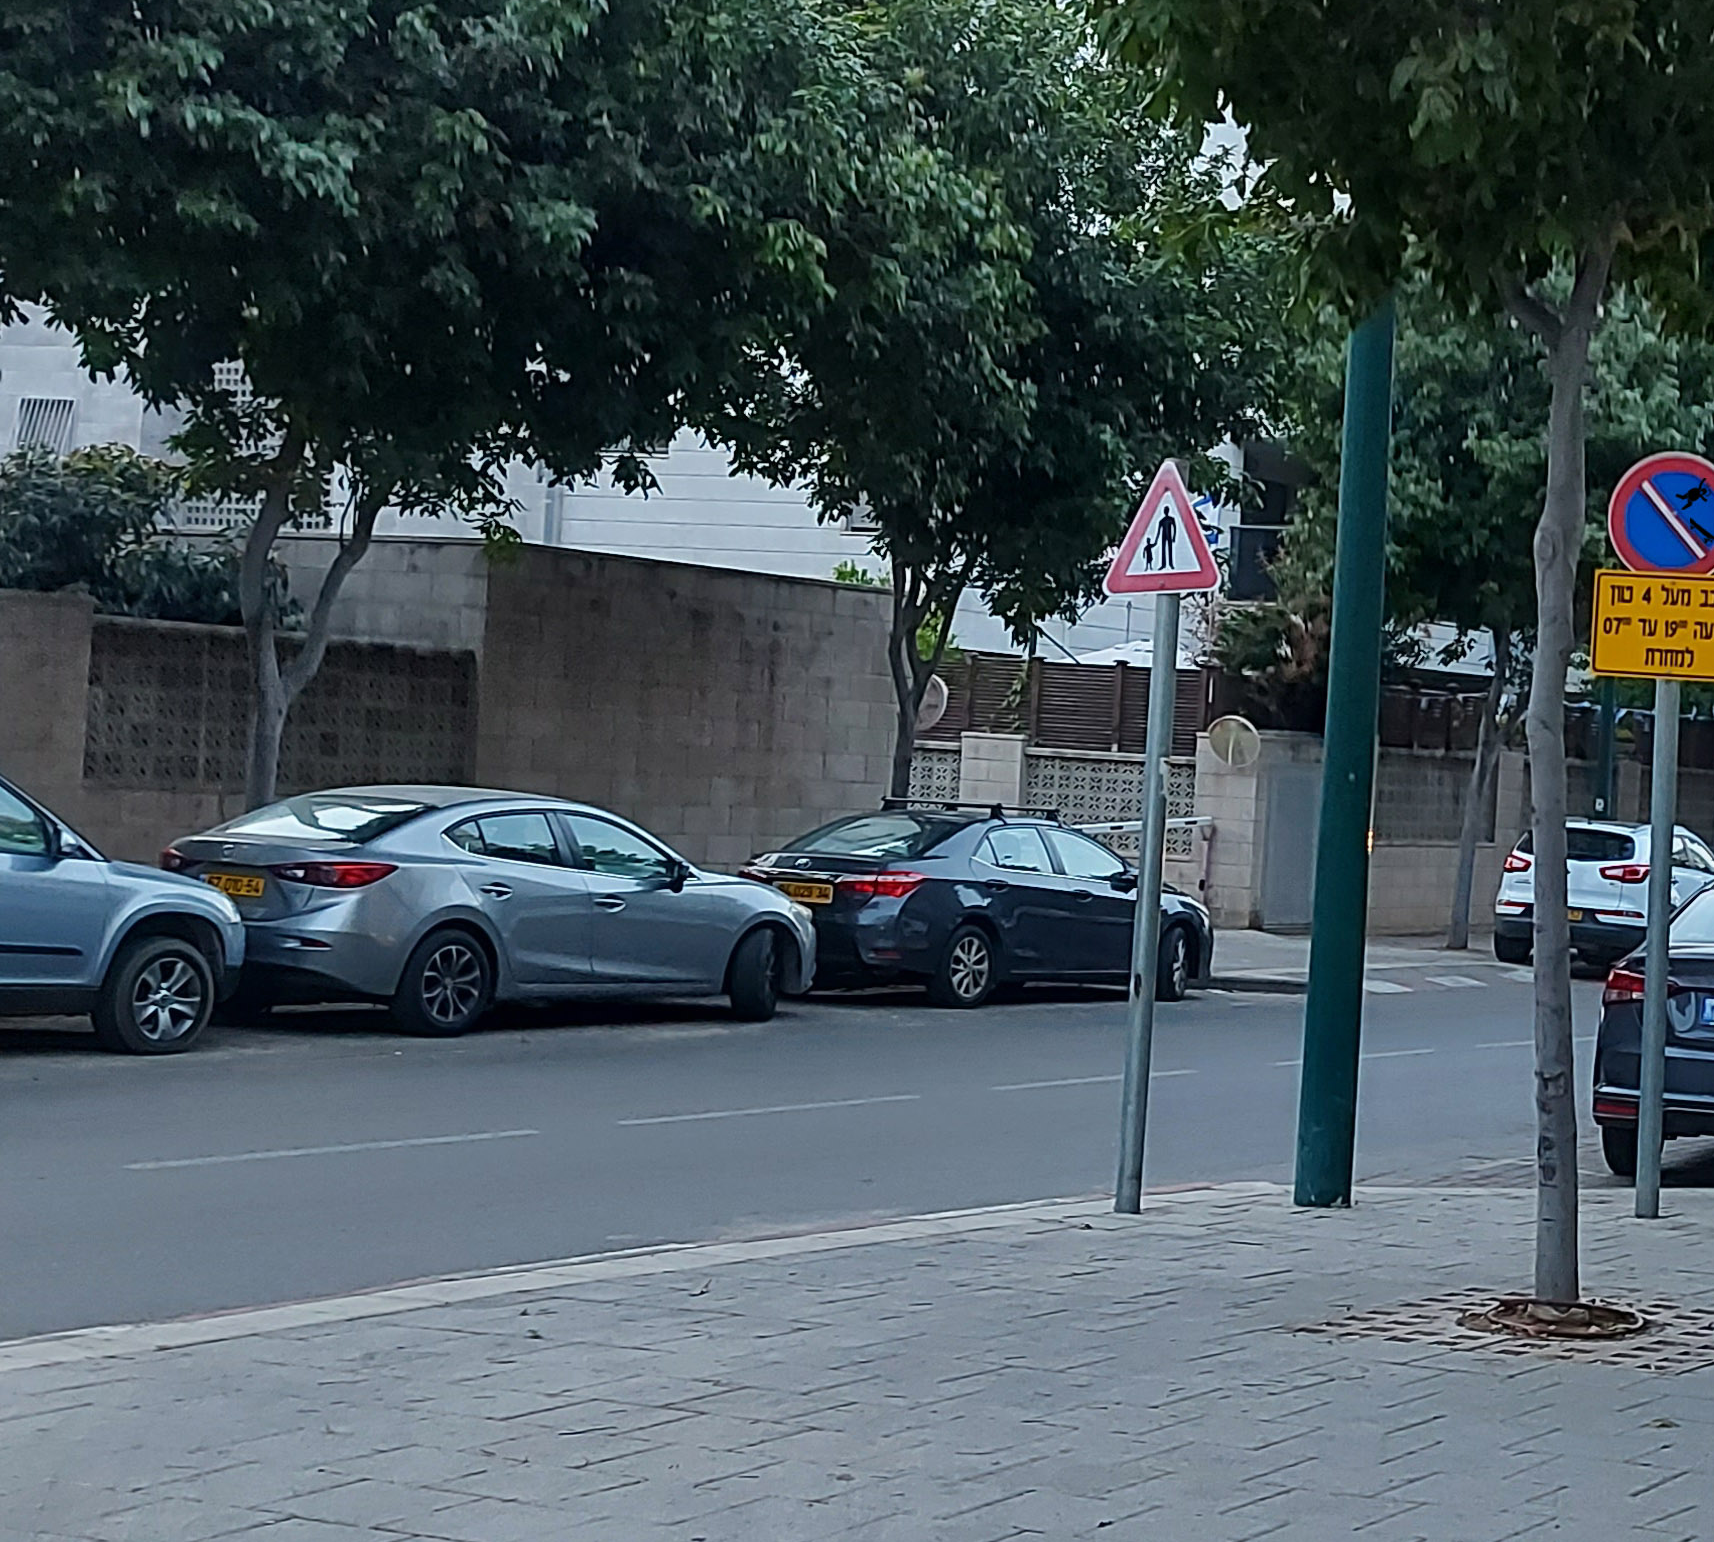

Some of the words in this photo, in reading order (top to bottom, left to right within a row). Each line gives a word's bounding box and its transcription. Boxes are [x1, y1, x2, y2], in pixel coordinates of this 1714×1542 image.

[1610, 584, 1634, 606] טון
[1641, 586, 1651, 605] 4
[1661, 584, 1691, 606] מעל
[1638, 618, 1658, 637] עד
[1644, 646, 1694, 668] למחרת
